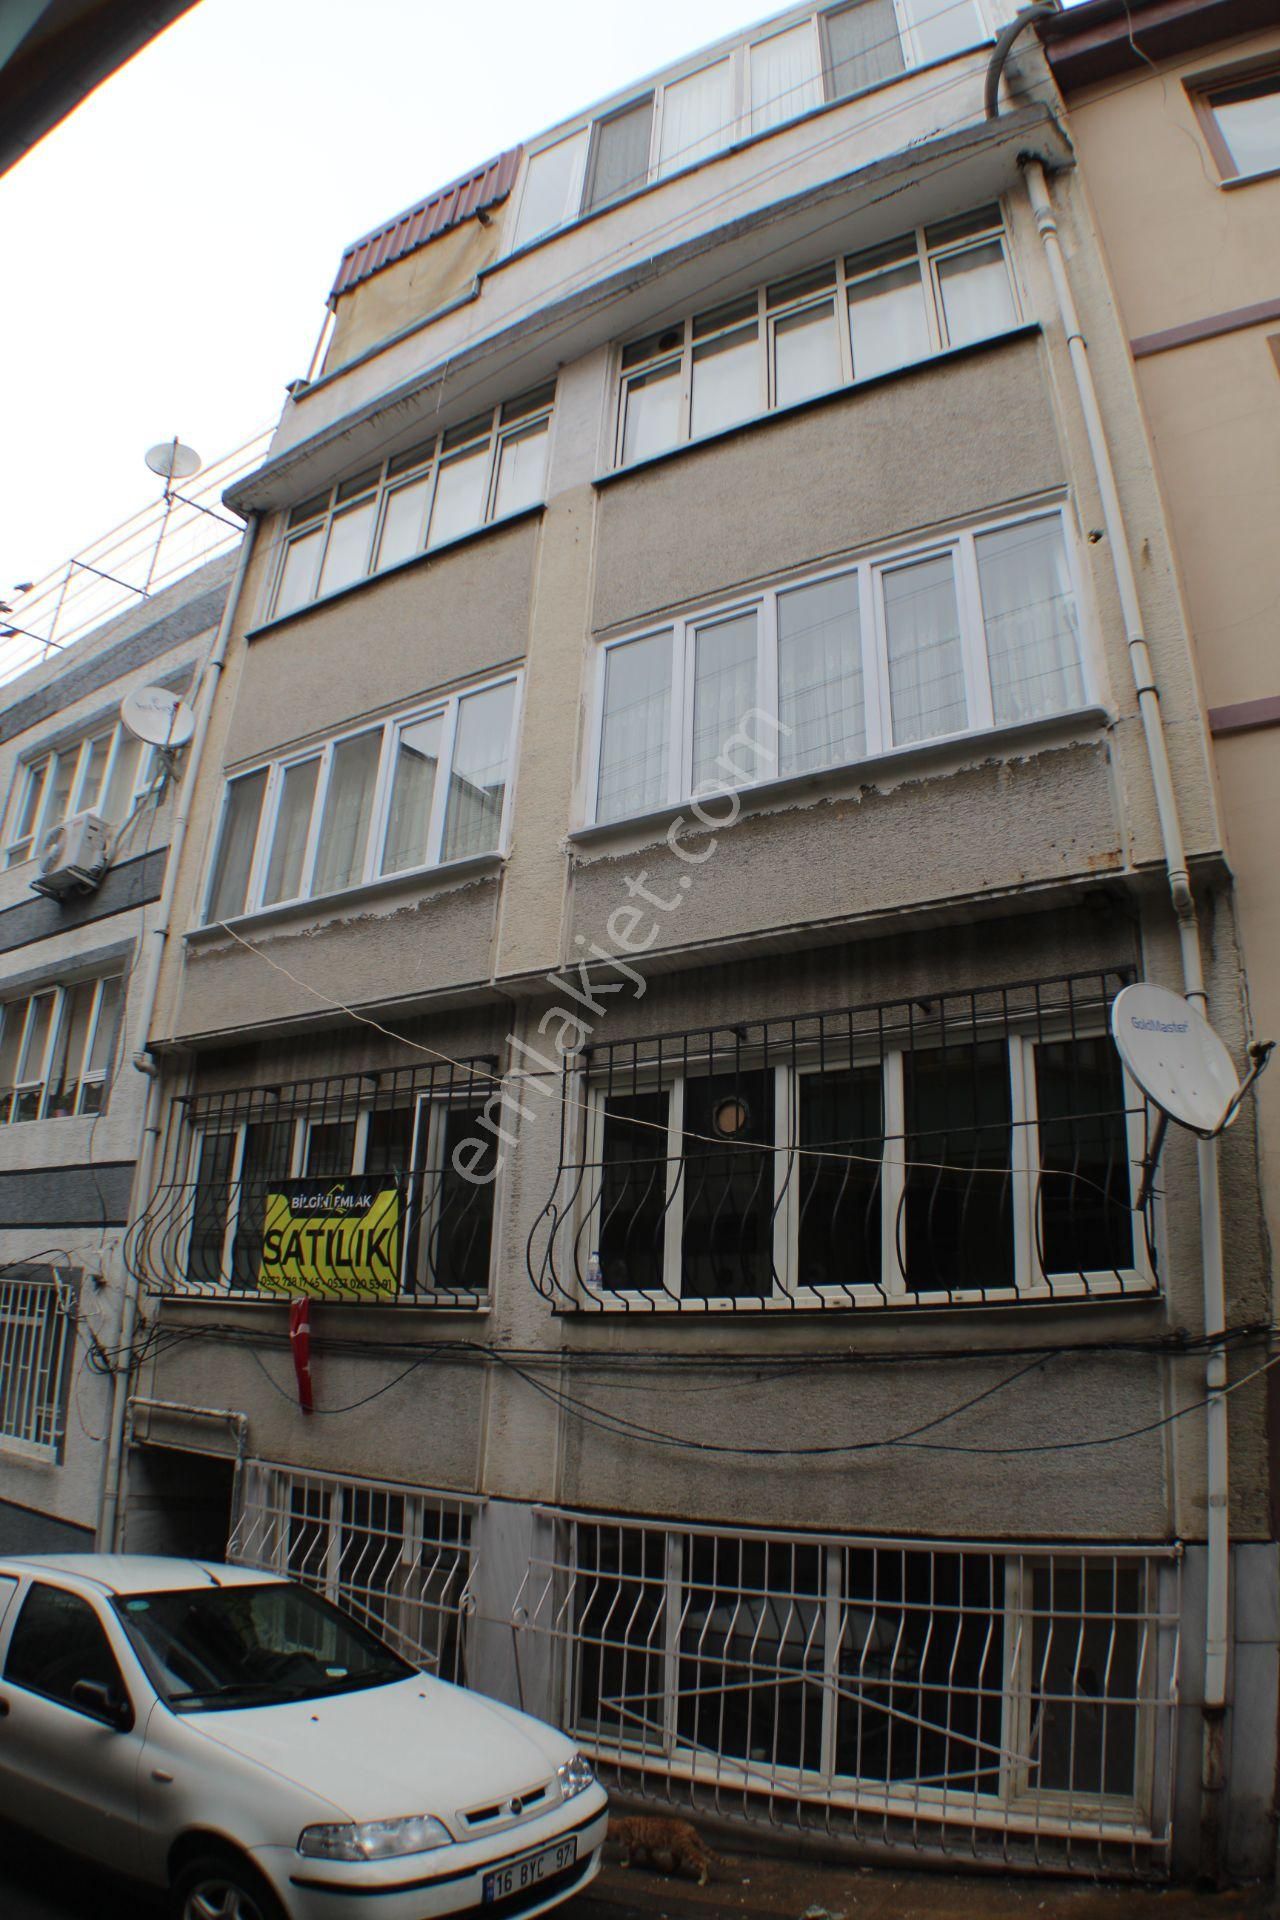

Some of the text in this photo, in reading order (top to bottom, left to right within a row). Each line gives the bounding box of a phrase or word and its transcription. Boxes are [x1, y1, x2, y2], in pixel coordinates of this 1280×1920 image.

[1130, 1017, 1189, 1033] GoldMaster
[263, 1228, 391, 1267] SATILIK
[494, 1844, 571, 1896] 16 BYC 97
